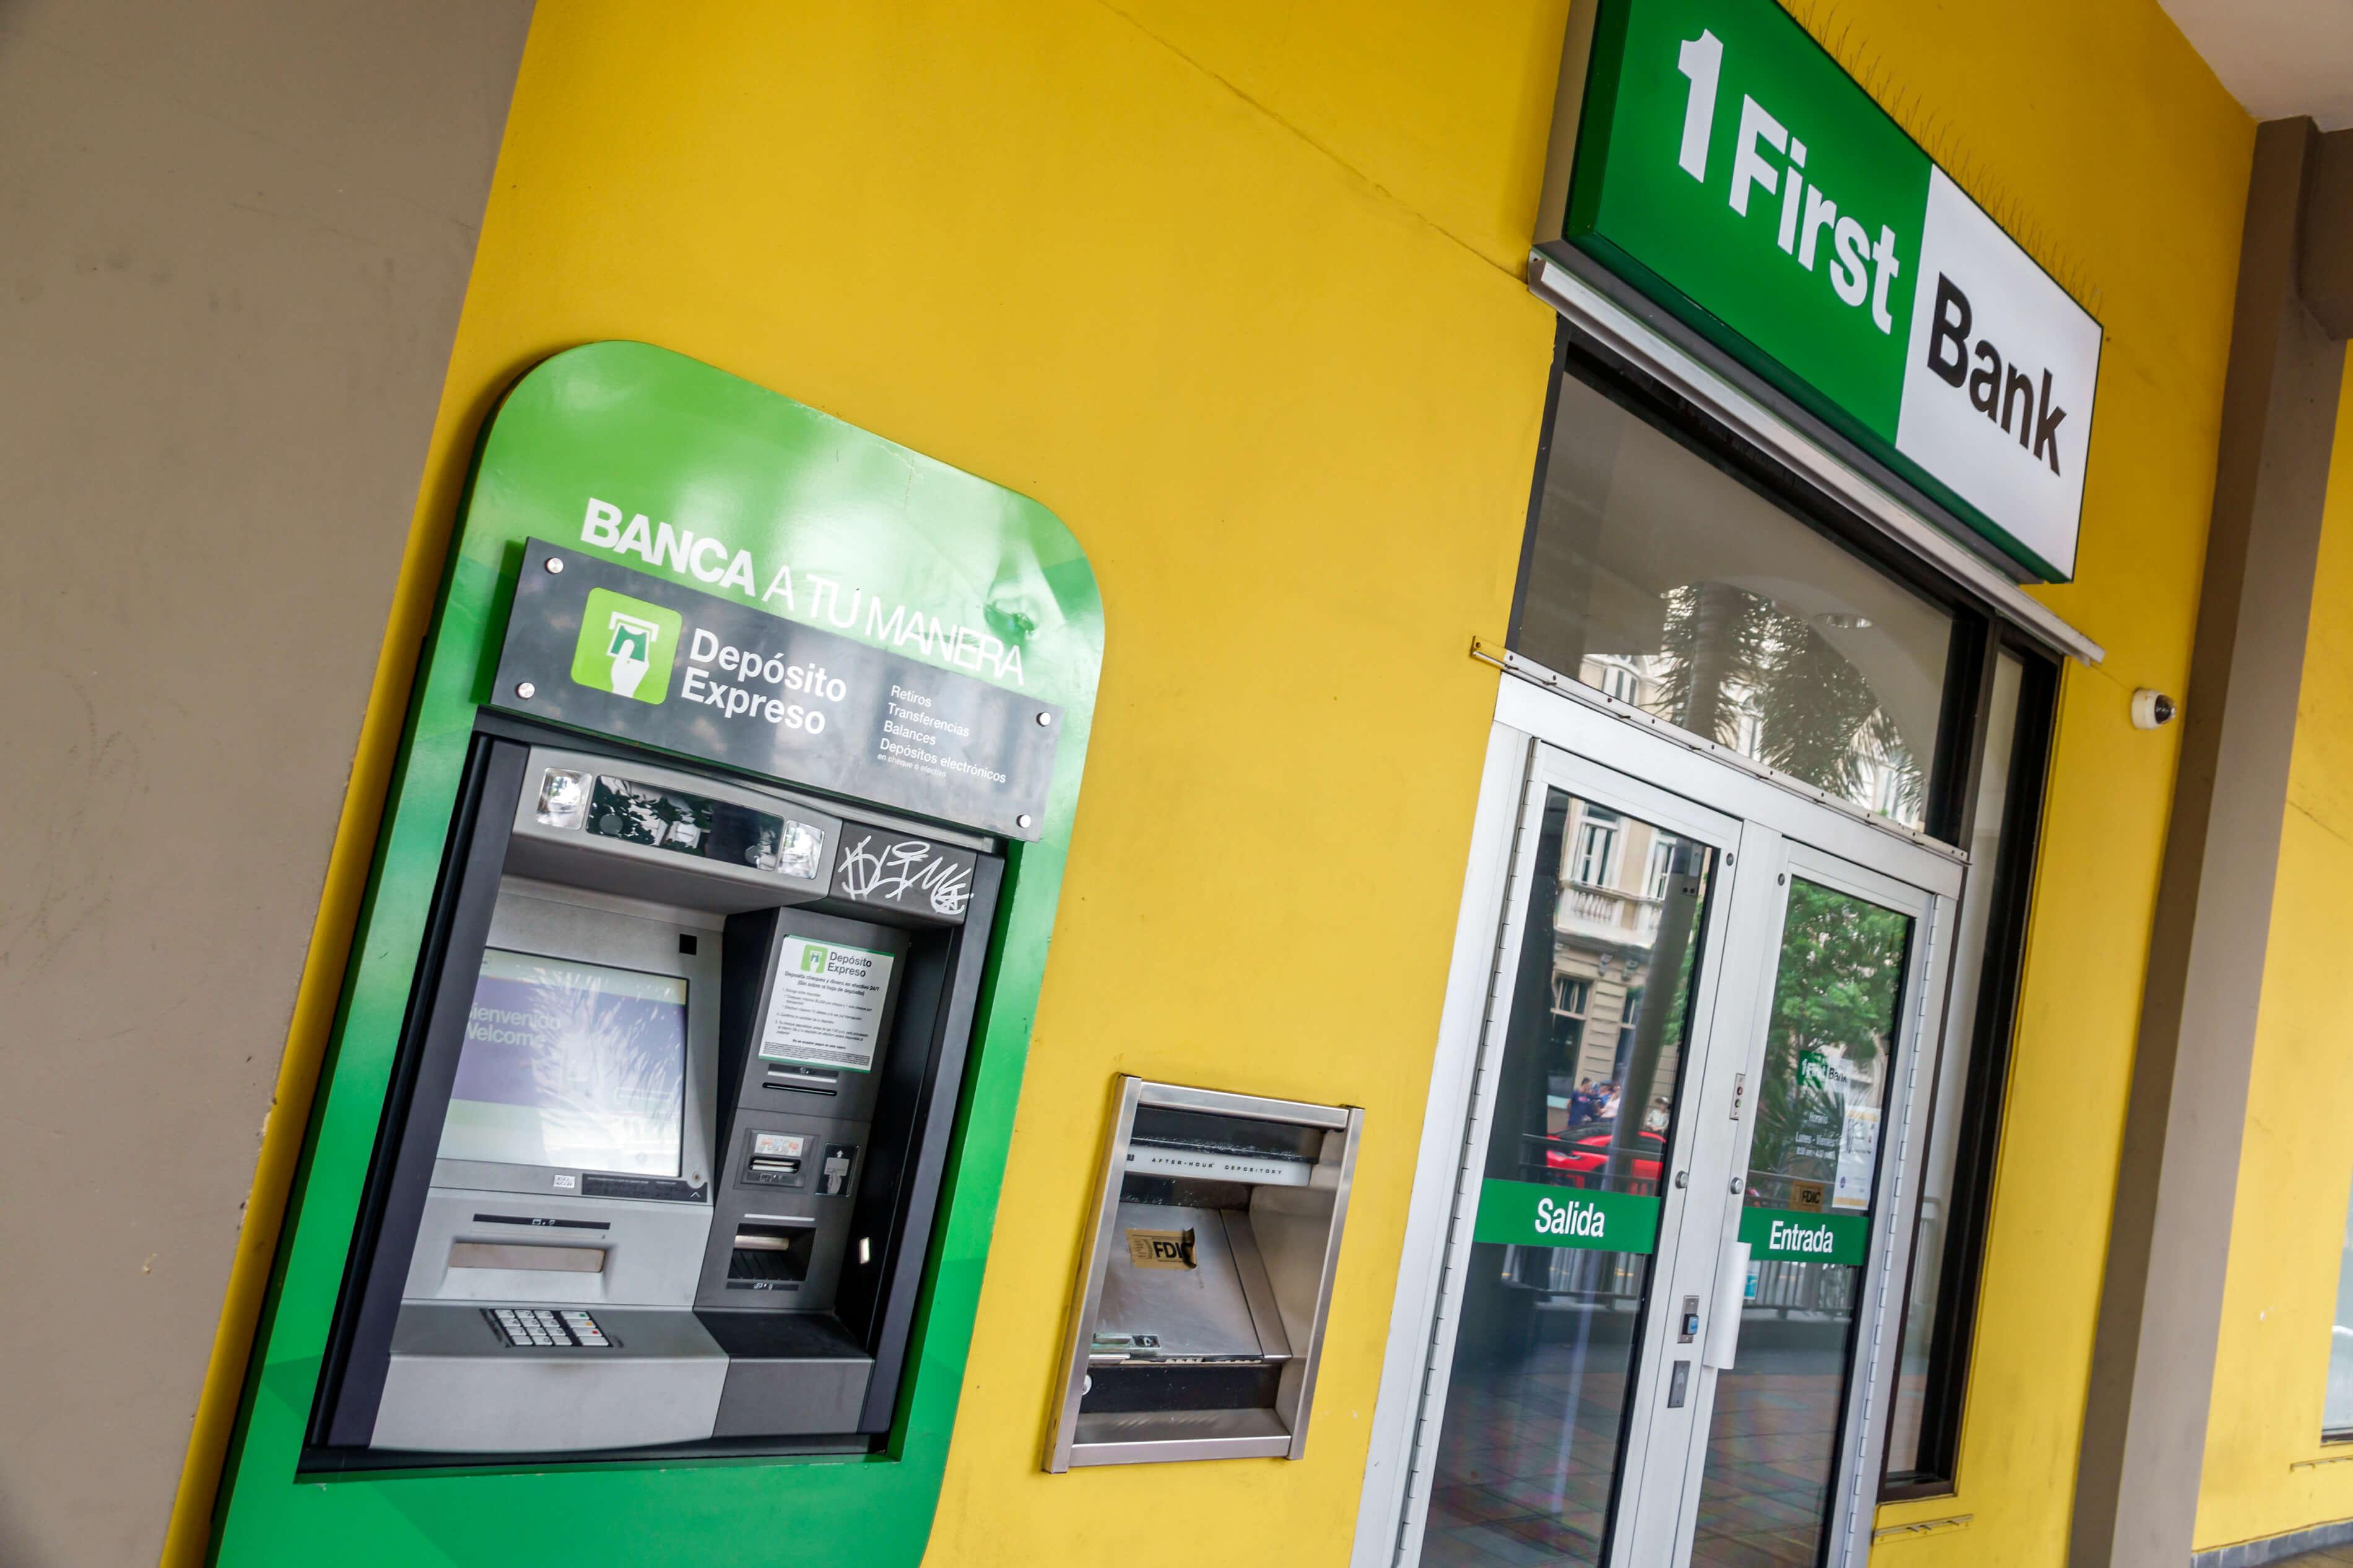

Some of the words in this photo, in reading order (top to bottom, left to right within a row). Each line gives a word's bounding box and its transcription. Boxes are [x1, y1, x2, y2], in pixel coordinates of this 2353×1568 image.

[1677, 28, 1724, 184] 1
[1728, 93, 1900, 336] First
[1926, 271, 2068, 477] Bank
[581, 497, 757, 597] BANCA
[762, 565, 794, 613] A
[806, 573, 863, 630] TU
[865, 596, 1024, 686] MANERA
[689, 627, 847, 703] Depósito
[682, 666, 826, 735] Expreso
[890, 685, 932, 708] Retiros
[884, 720, 936, 745] Balances
[888, 702, 970, 737] Transferencias
[877, 753, 887, 761] en
[888, 755, 913, 769] cheque
[920, 765, 947, 778] efectivo
[880, 737, 937, 764] Depósitos
[940, 756, 1006, 783] electrónicos
[827, 962, 866, 977] Expreso
[829, 951, 872, 968] Depósito
[1224, 1164, 1282, 1174] DEPOSITORY
[1802, 1190, 1821, 1204] FDIC
[1534, 1197, 1606, 1238] Salida
[1769, 1220, 1833, 1253] Entrada
